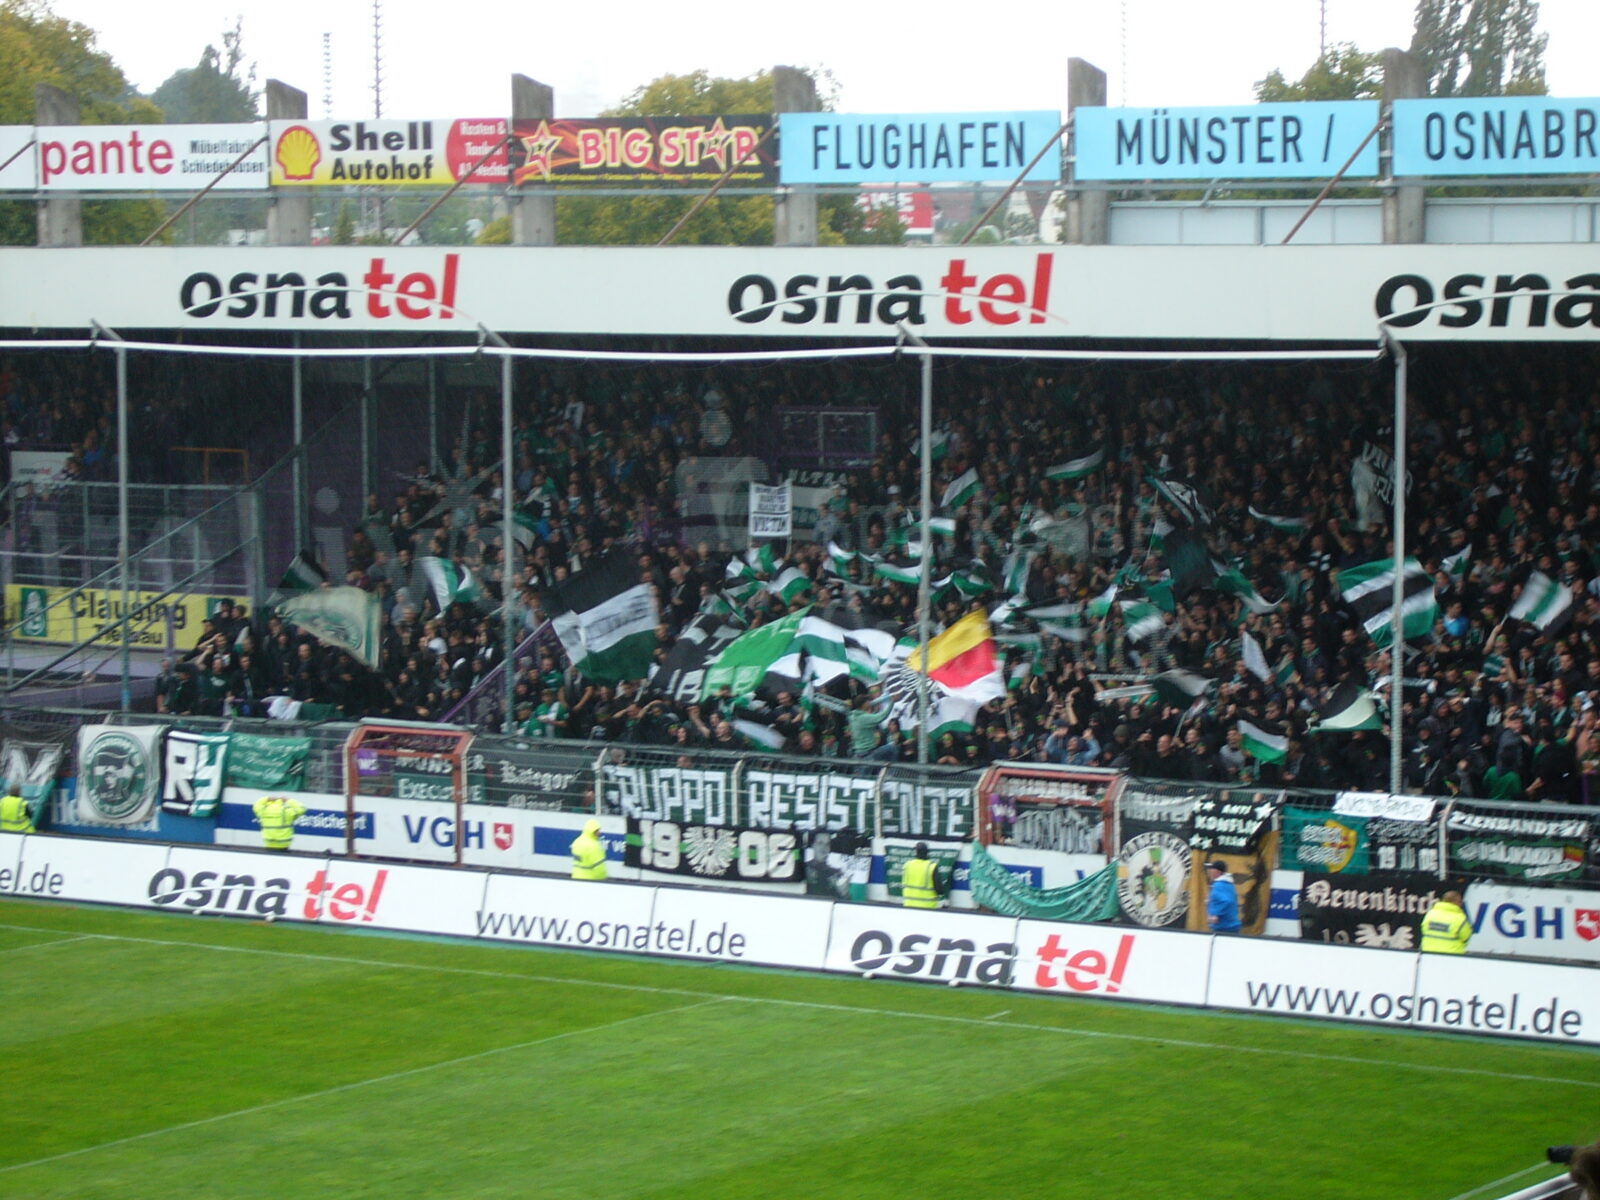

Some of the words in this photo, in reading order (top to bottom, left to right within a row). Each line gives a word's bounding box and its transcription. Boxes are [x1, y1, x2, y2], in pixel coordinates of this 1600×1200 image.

[41, 130, 174, 185] pante
[330, 122, 433, 151] Shell
[577, 127, 654, 169] BIG
[812, 120, 1026, 170] FLUGHAFEN
[1116, 109, 1303, 166] MÜNSTER
[331, 154, 433, 180] Autohof
[71, 590, 187, 630] Clausing
[746, 769, 973, 837] RESISTENTE
[403, 815, 484, 850] VGH
[640, 820, 681, 870] 19
[738, 831, 797, 879] 06
[0, 861, 64, 895] el.de
[476, 910, 747, 957] www.osnatel.de
[1462, 902, 1563, 940] VGH
[1247, 981, 1582, 1038] www.osnatel.de
